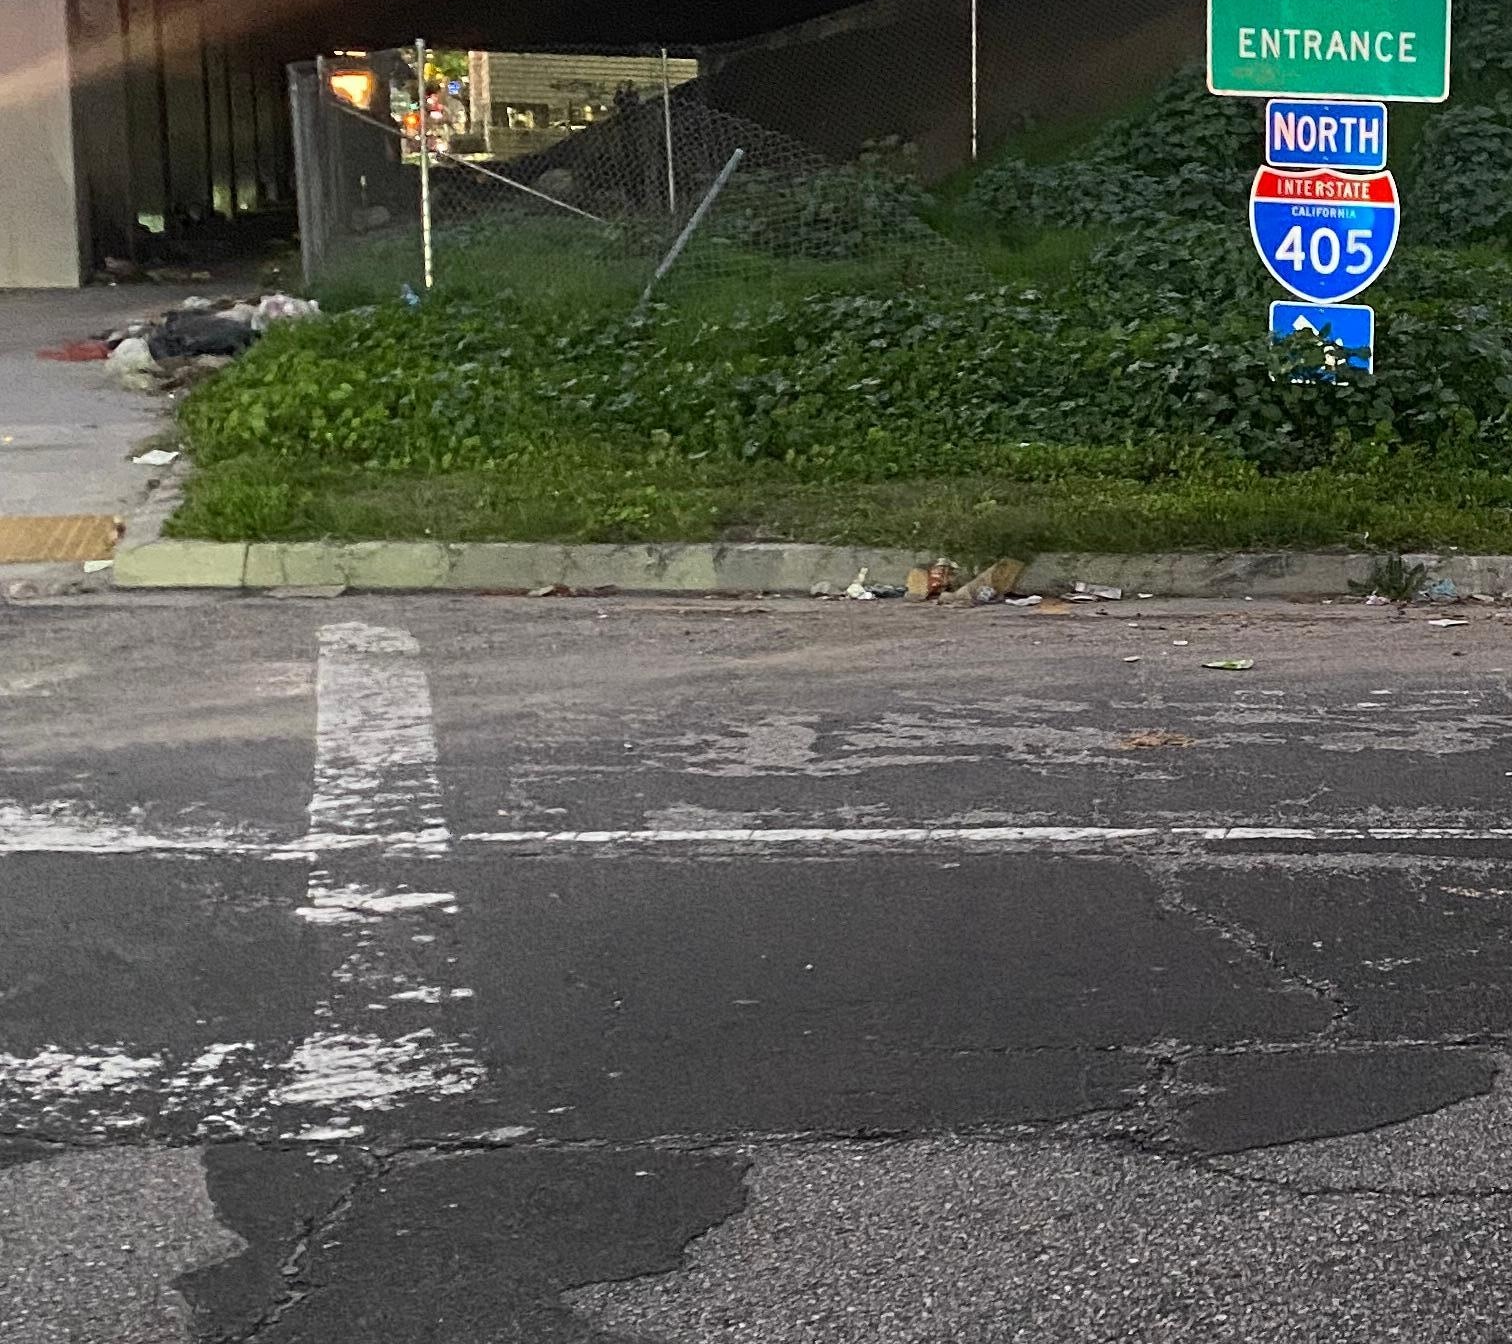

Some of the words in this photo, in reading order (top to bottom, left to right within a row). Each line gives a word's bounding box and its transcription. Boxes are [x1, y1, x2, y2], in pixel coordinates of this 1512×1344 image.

[1238, 27, 1417, 63] ENTRANCE
[1273, 111, 1380, 154] NORTH
[1277, 179, 1371, 199] INTERSTATE
[1291, 206, 1356, 218] CALIFORNIA
[1275, 225, 1373, 274] 405
